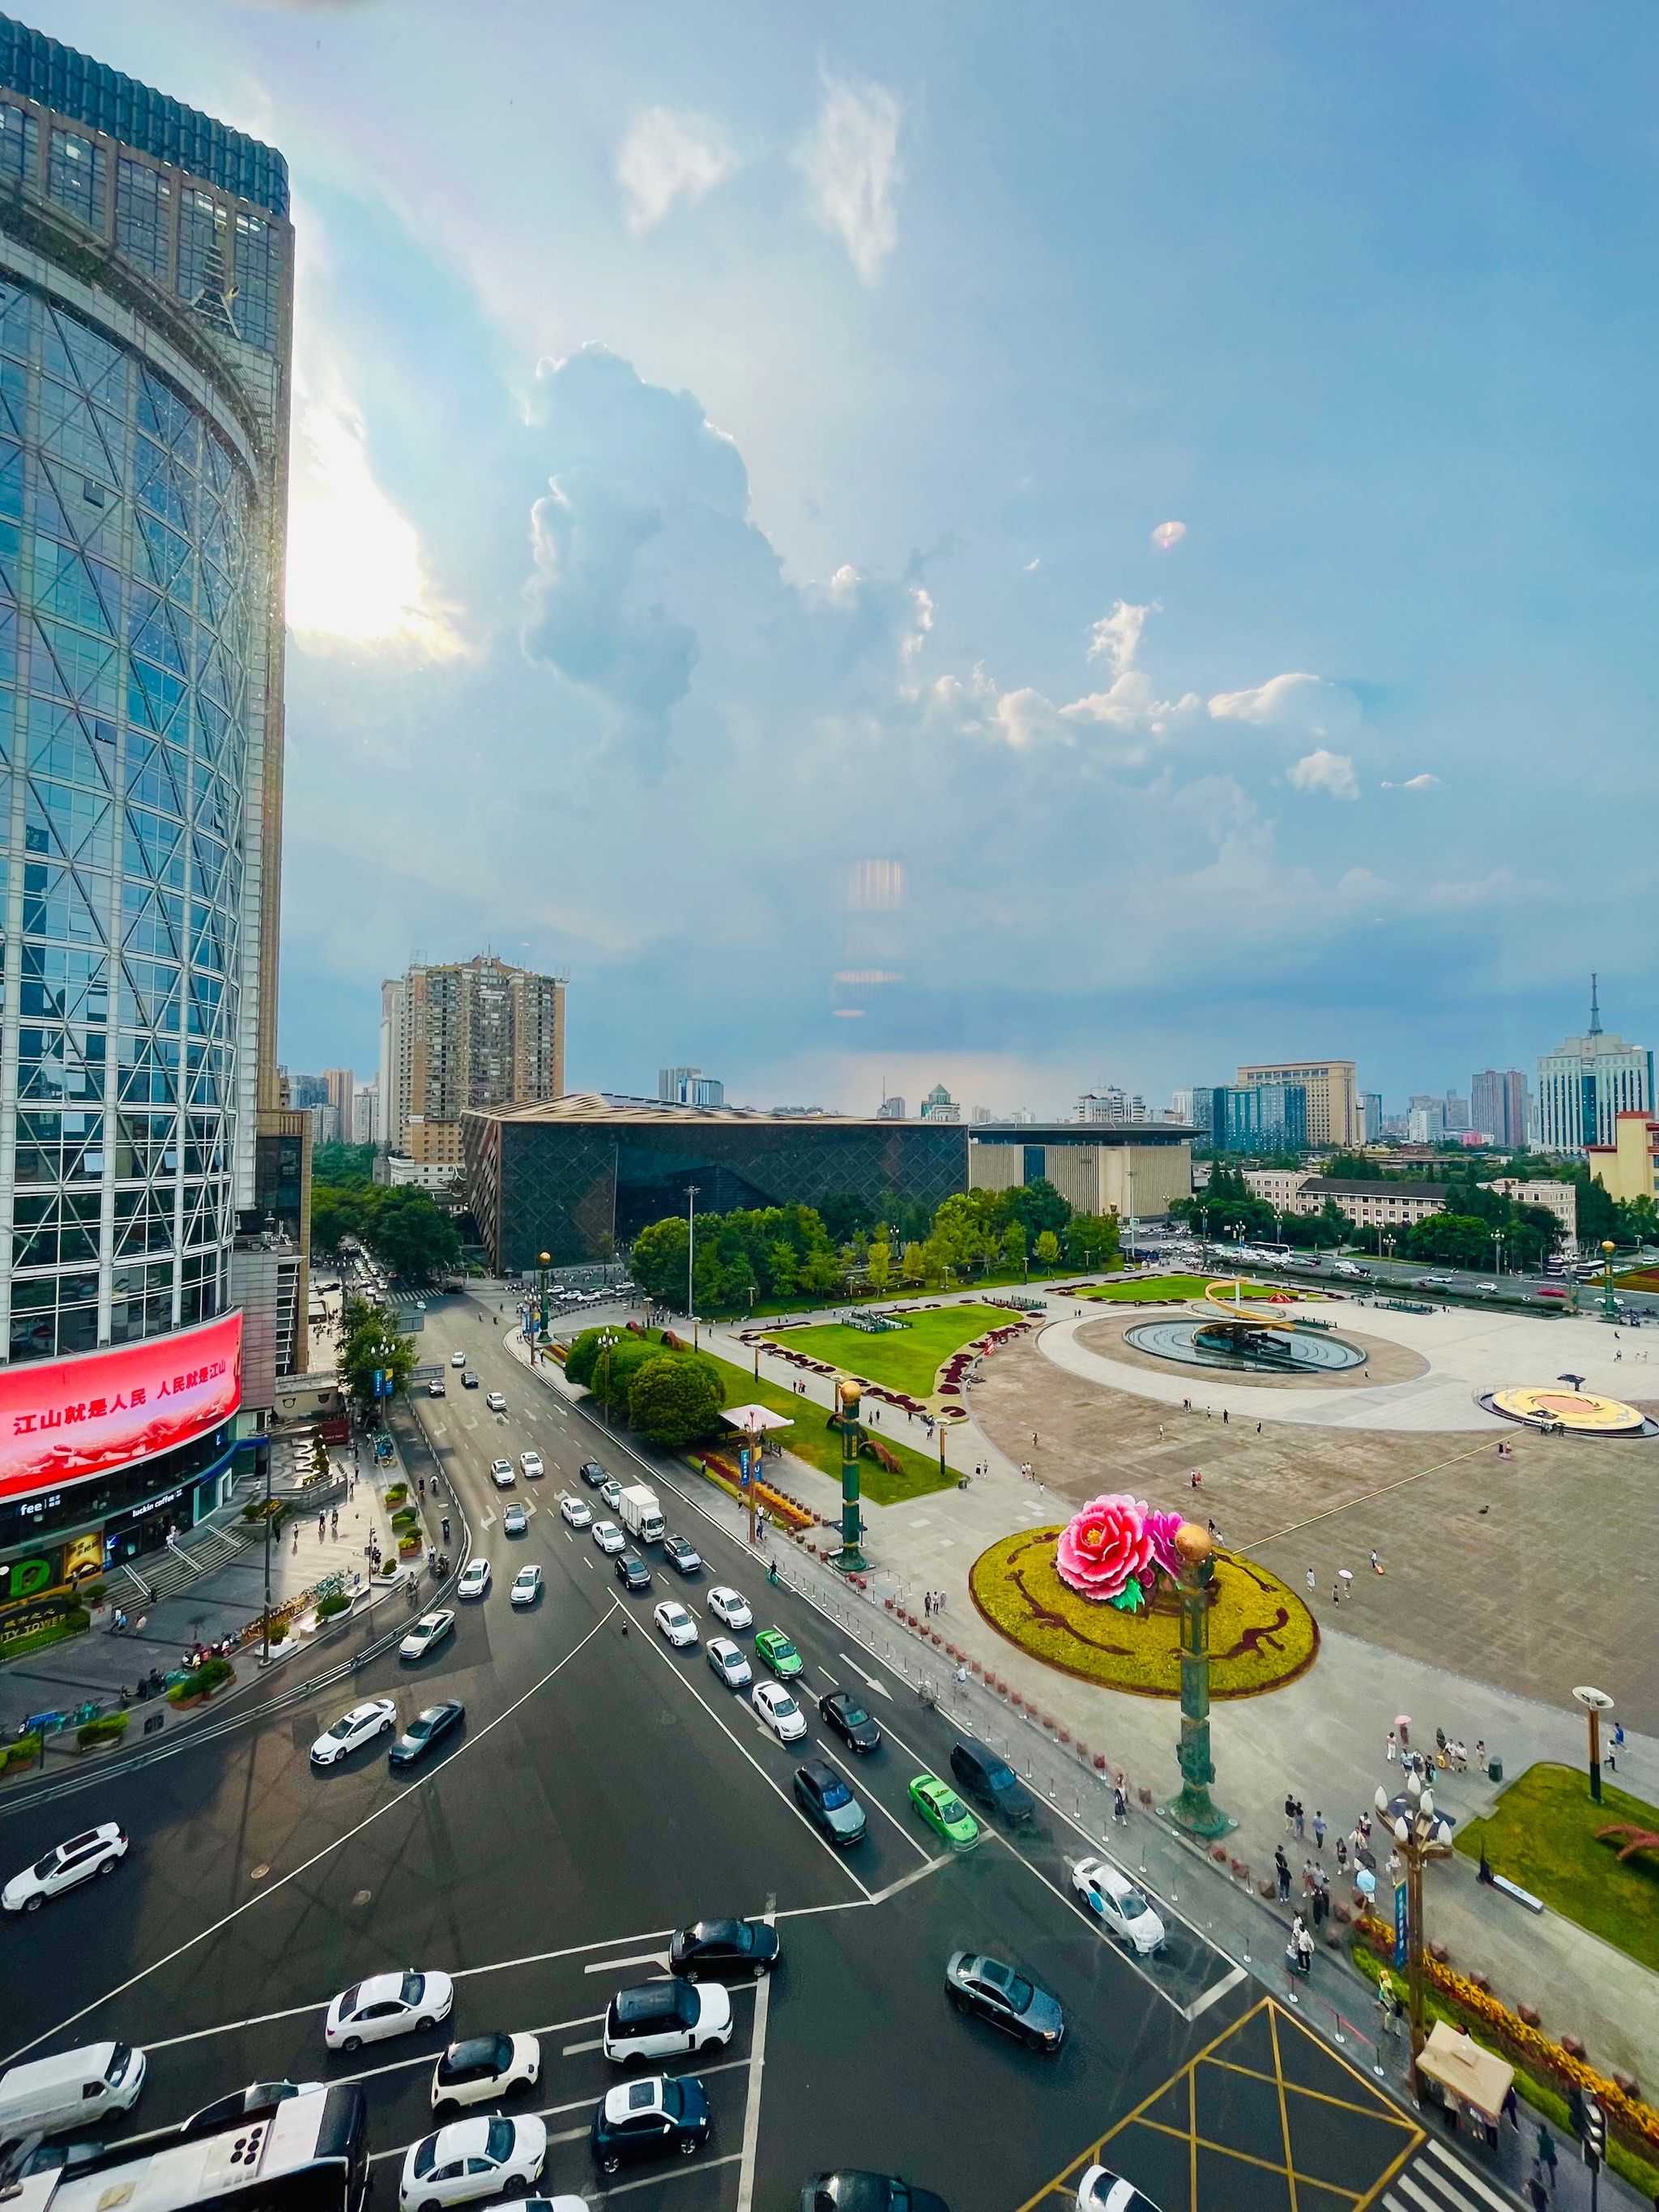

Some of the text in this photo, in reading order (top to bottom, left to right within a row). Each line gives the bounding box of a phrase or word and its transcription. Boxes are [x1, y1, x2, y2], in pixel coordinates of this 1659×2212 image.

[14, 1359, 226, 1435] 江山就是人民 人民就是江山
[132, 1494, 174, 1518] luckin coffee
[24, 1613, 66, 1635] TOWER
